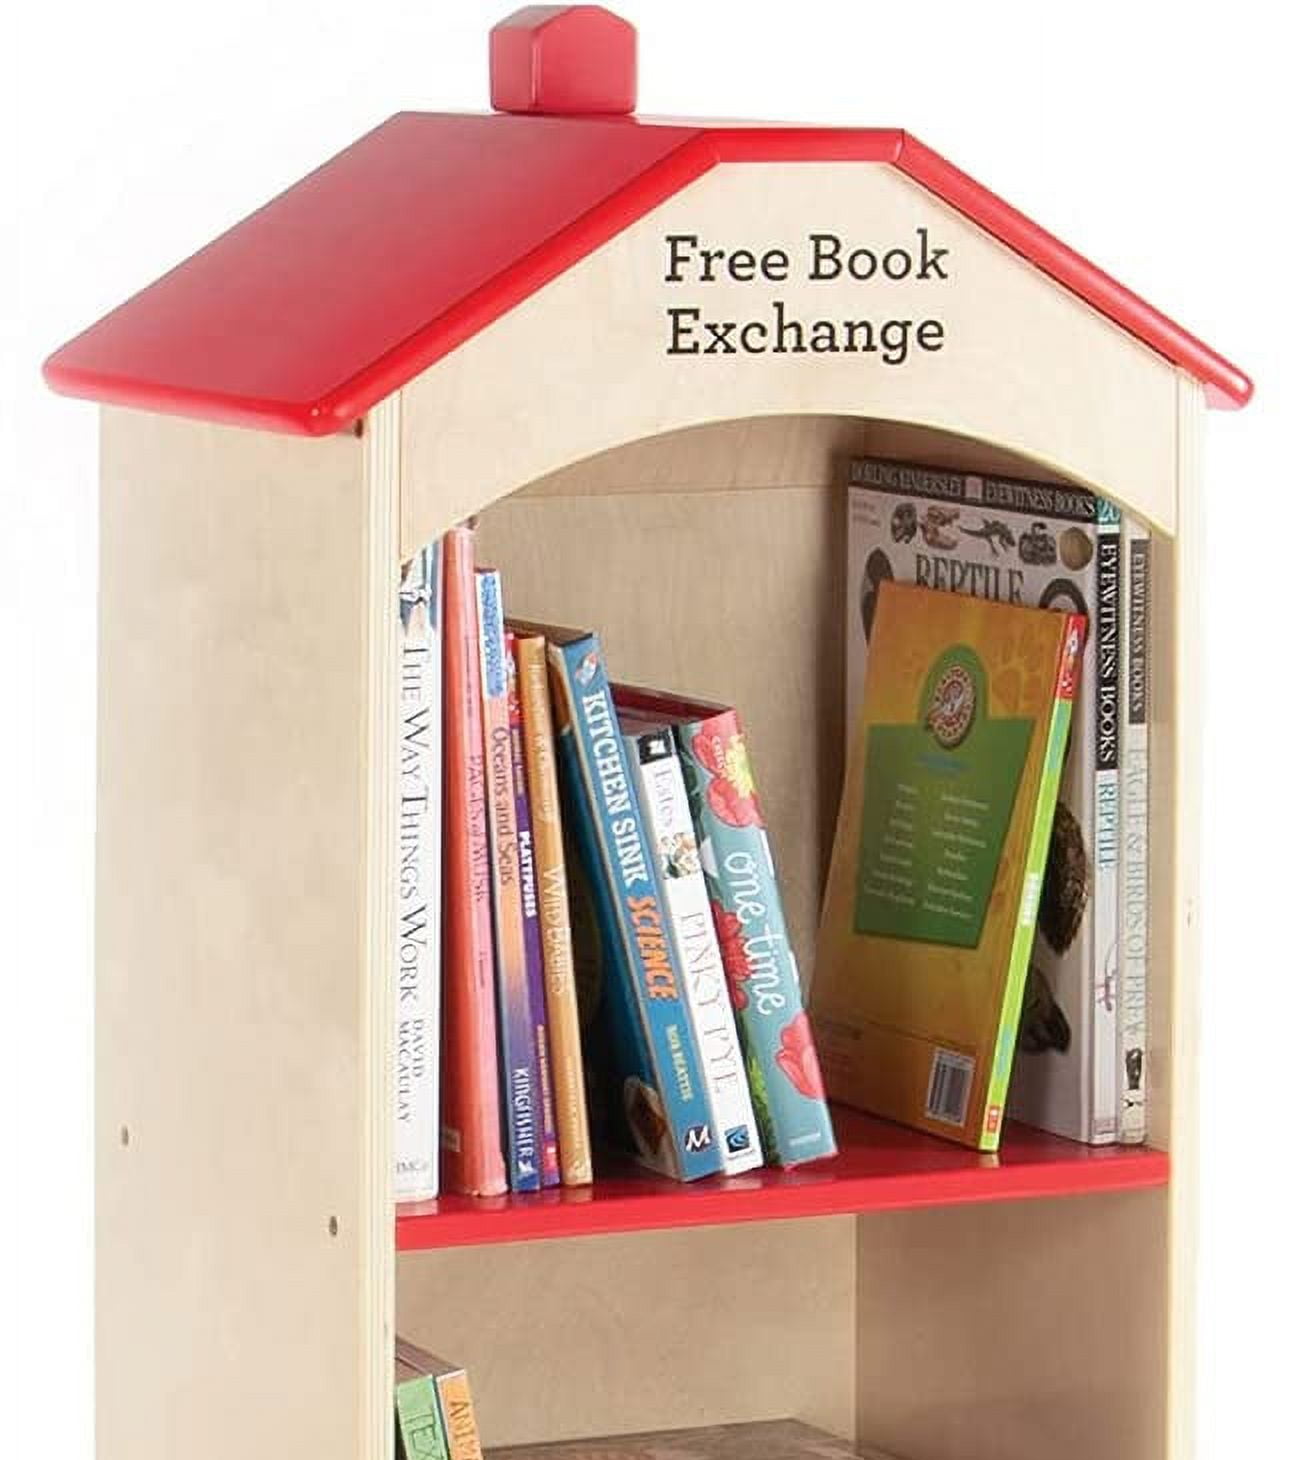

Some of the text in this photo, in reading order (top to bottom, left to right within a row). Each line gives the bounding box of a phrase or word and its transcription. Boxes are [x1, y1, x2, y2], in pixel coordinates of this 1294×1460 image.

[664, 227, 950, 282] Free Book
[666, 301, 945, 365] Exchange
[1100, 543, 1118, 764] EYEWITNESS BOOKS
[1131, 553, 1146, 713] EYEWITNESS BOOKS
[399, 641, 431, 1002] THE WAY THINGS WORK
[491, 727, 516, 885] Oceans and Seas
[582, 690, 679, 1001] KITCHEN SINK SCIENCE
[1098, 783, 1119, 869] REPTILE
[680, 910, 740, 1094] PINKY PYE
[723, 850, 787, 1016] one time
[397, 1020, 411, 1122] MACAULAY
[412, 1018, 424, 1079] DAVID
[514, 1067, 535, 1158] KINGFISHER
